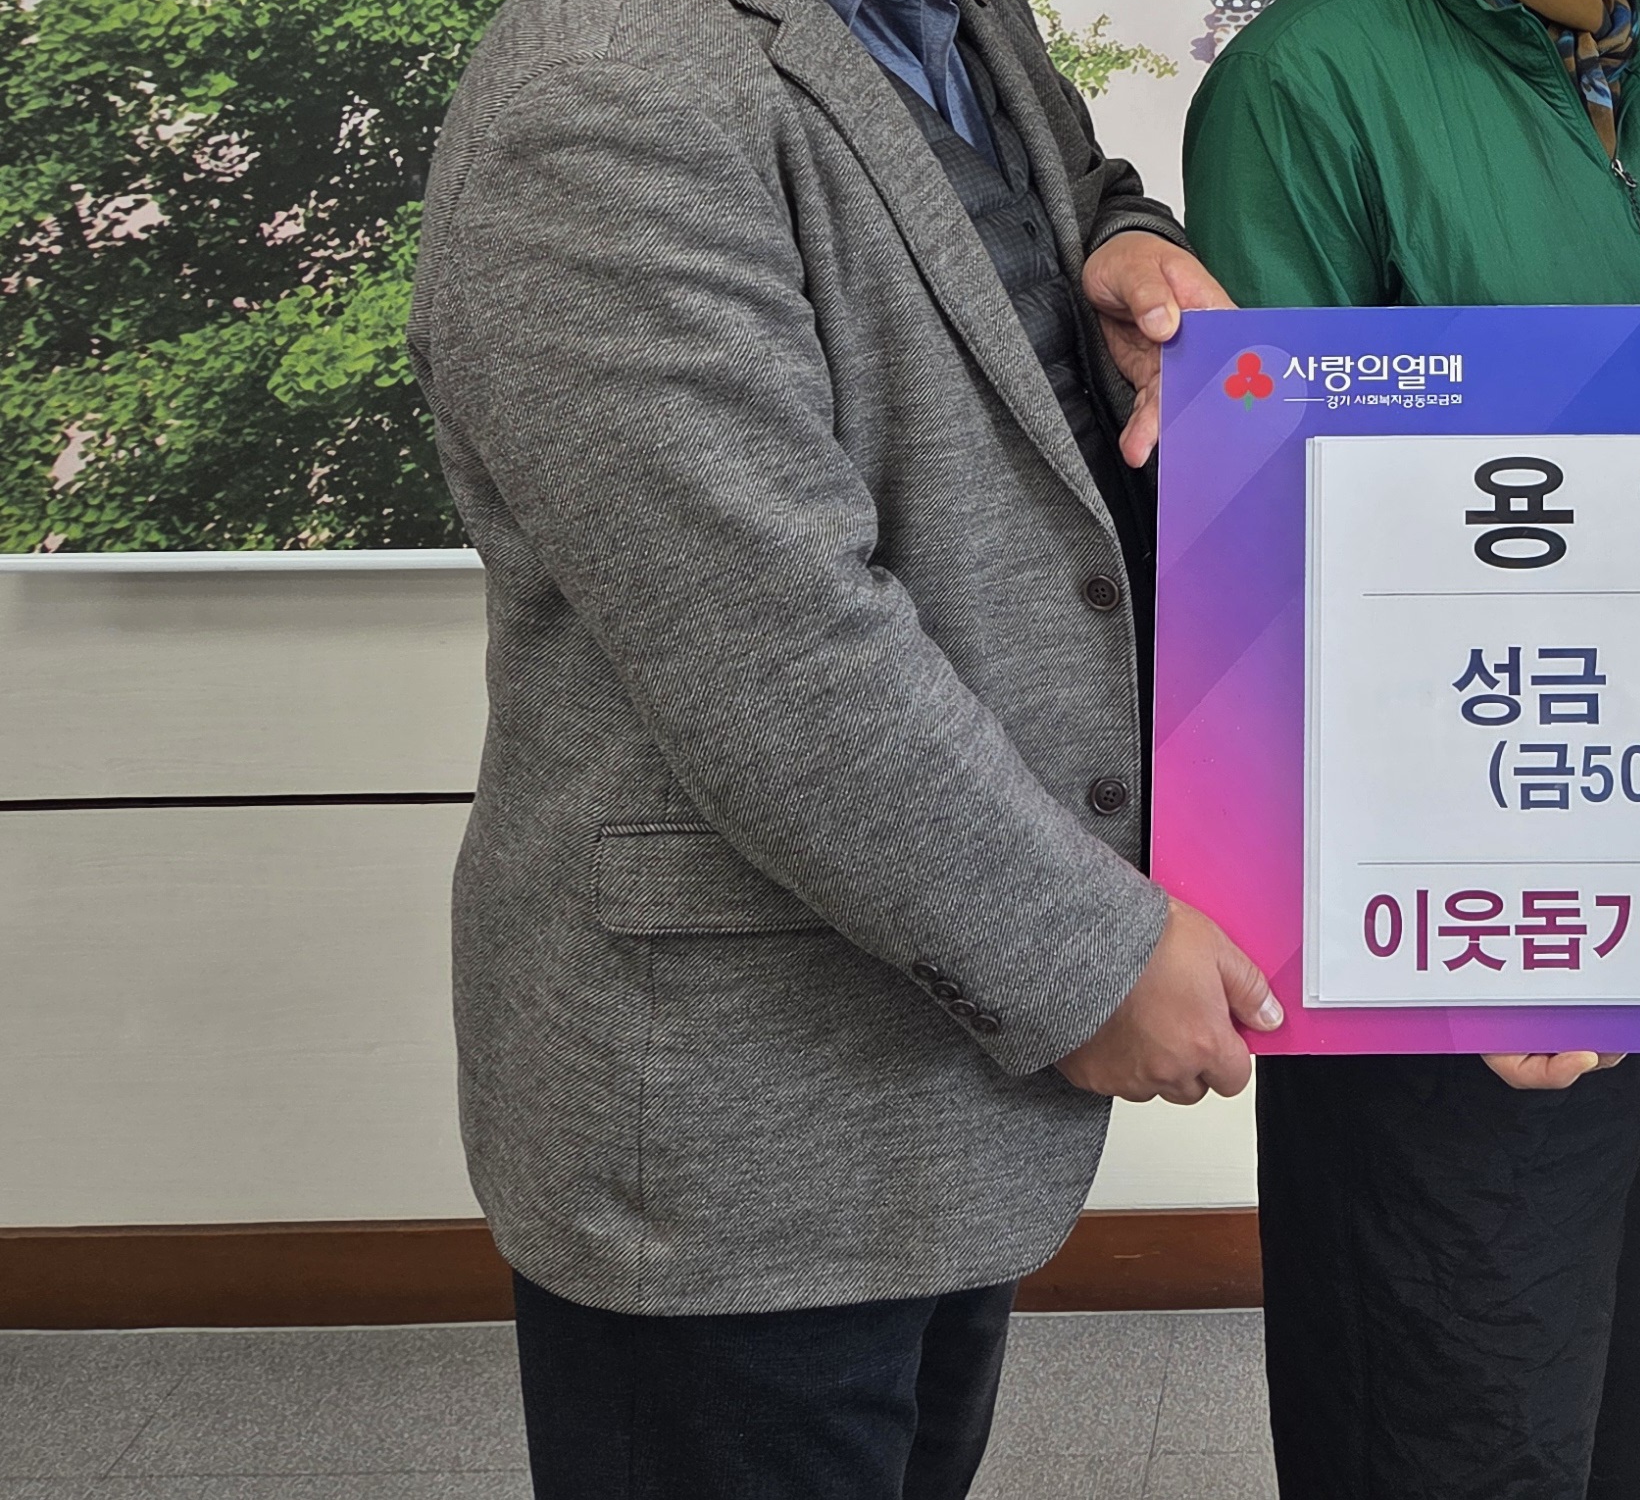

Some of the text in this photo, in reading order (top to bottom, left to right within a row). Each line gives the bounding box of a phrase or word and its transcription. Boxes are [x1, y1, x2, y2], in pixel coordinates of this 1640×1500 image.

[1282, 354, 1463, 392] 사랑의열매
[1326, 393, 1463, 410] 경기 사회복지공동모금회
[1452, 646, 1607, 727] 성금
